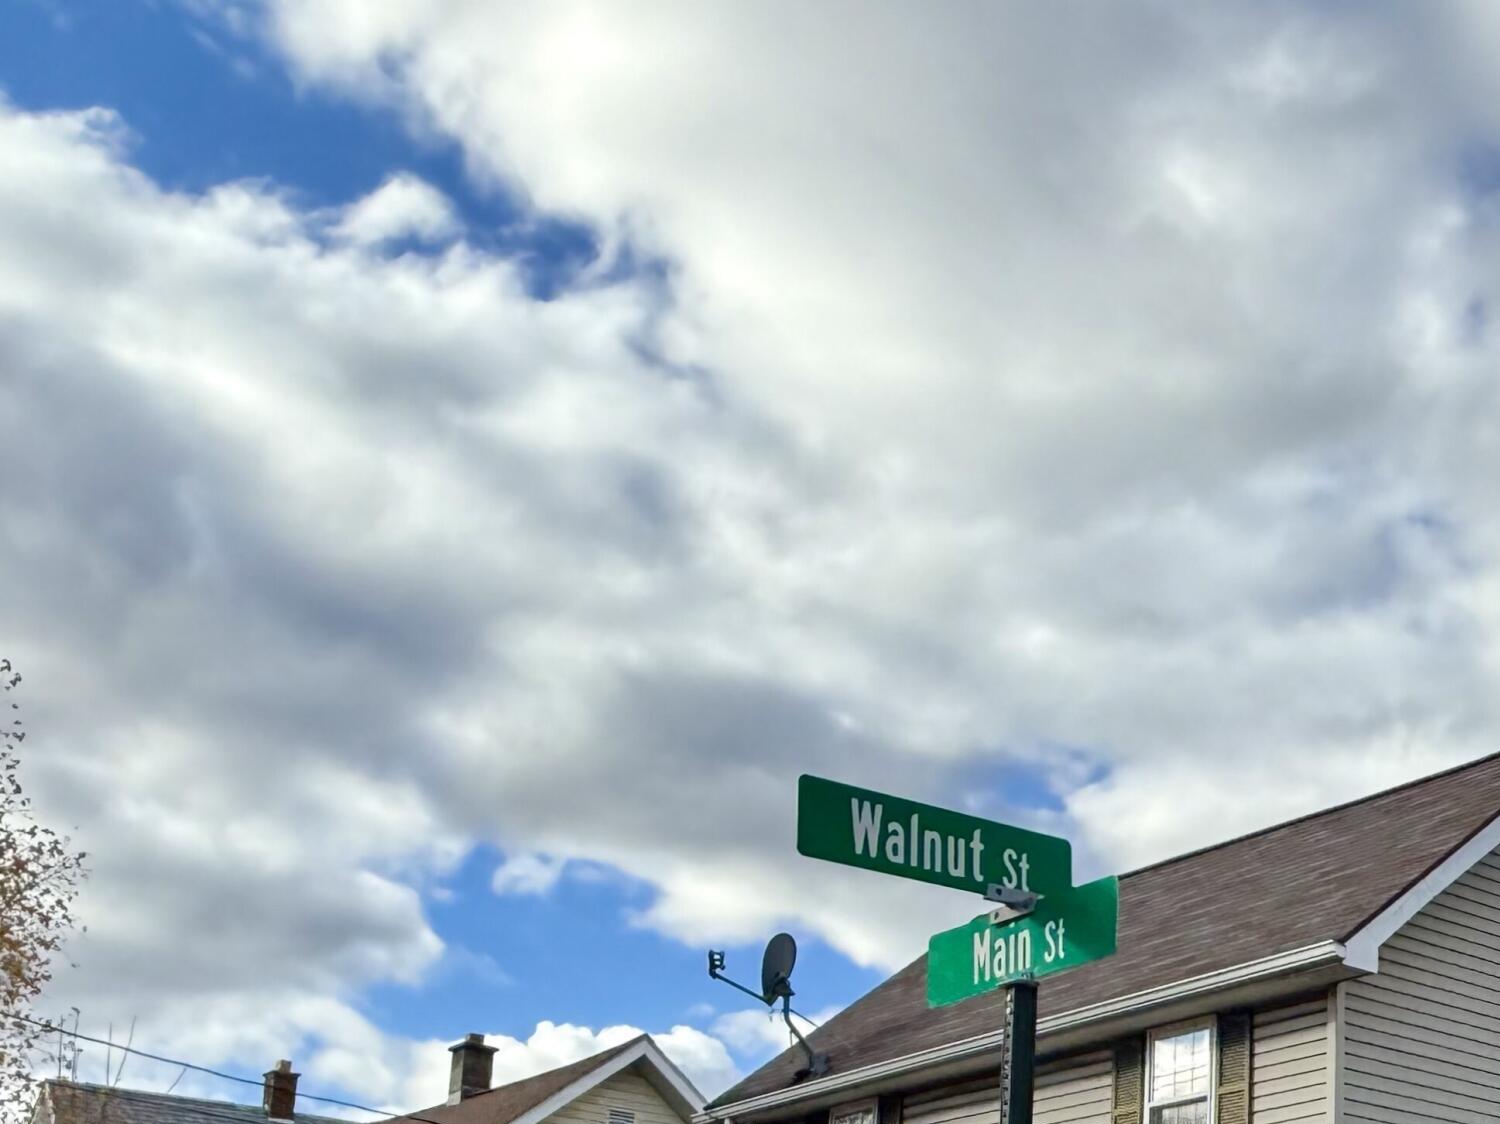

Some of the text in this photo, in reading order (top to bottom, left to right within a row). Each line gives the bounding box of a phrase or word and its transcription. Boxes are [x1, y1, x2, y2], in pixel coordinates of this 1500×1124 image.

[851, 797, 1031, 892] Walnut St
[973, 917, 1066, 985] Main St
